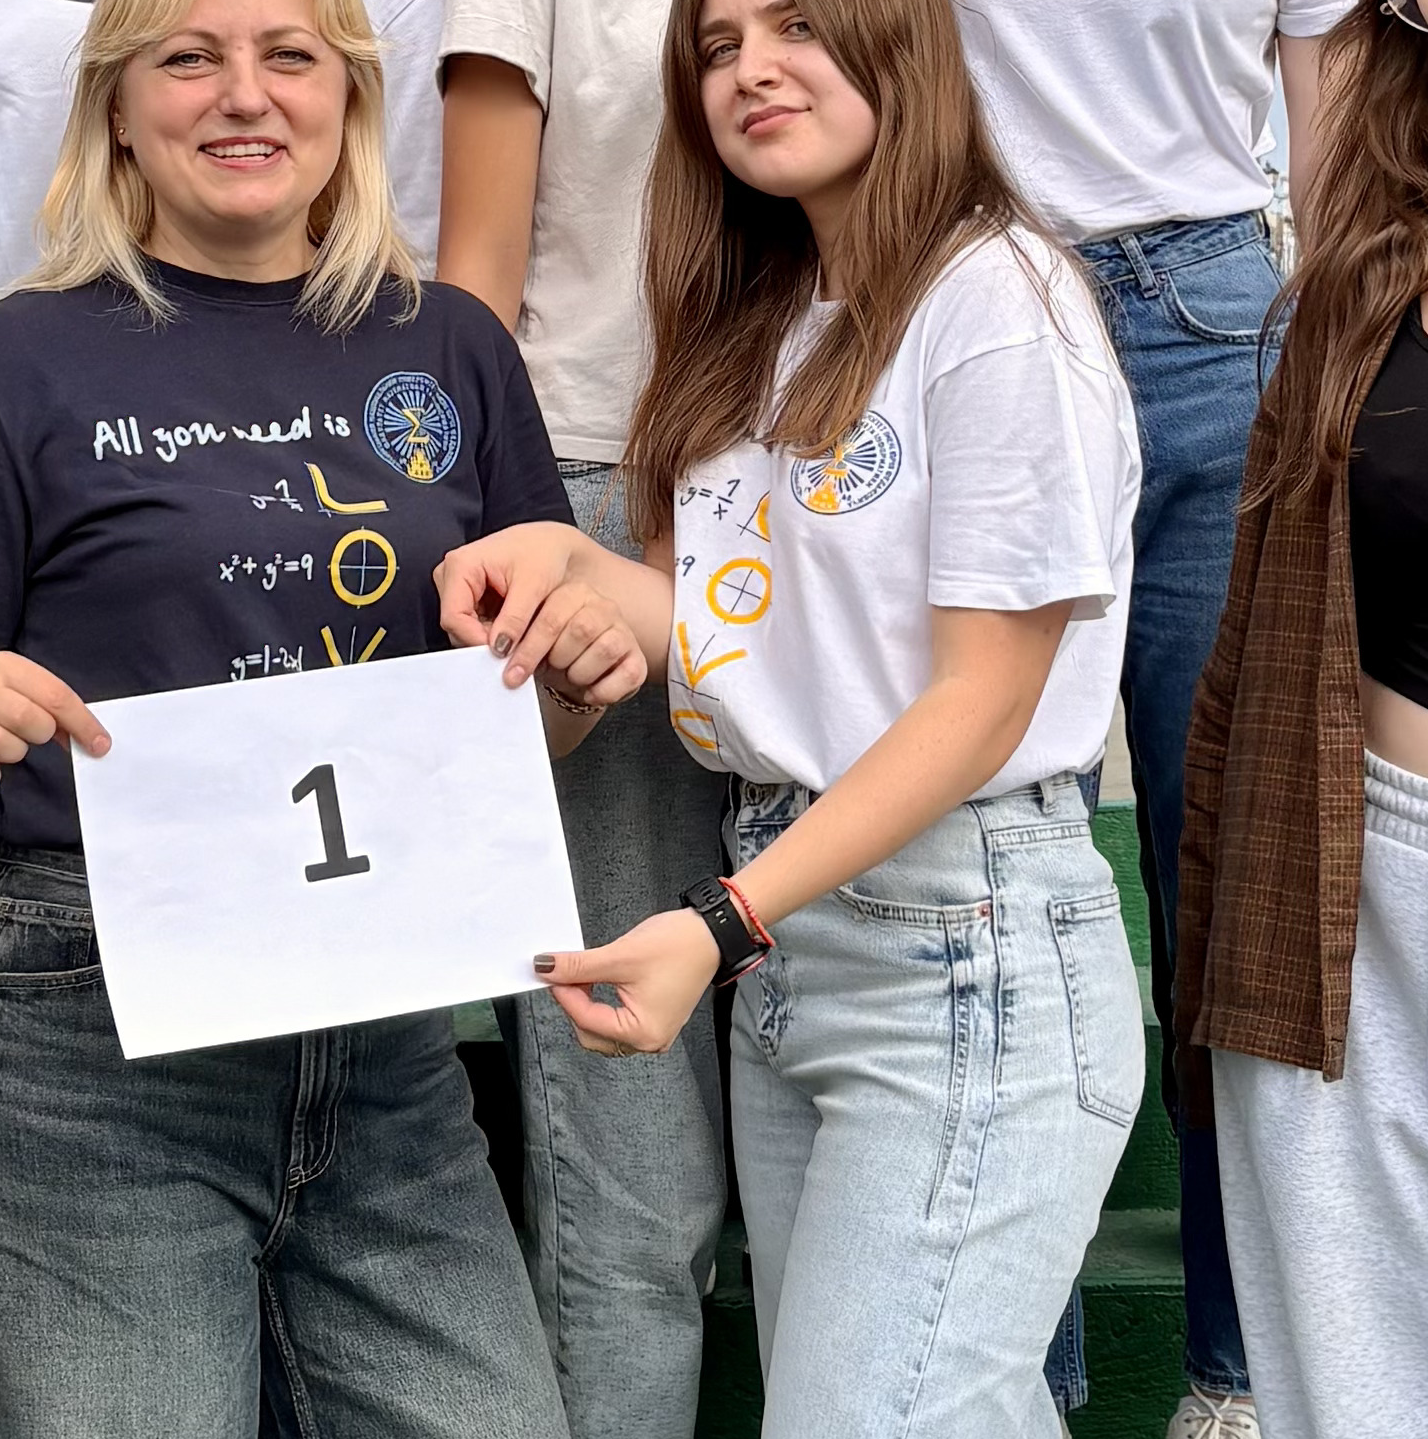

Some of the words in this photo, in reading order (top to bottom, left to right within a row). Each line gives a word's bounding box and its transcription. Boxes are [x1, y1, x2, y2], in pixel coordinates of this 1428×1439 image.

[93, 416, 144, 461] All
[152, 422, 227, 463] you
[231, 405, 313, 443] need
[323, 413, 352, 437] is
[291, 764, 370, 883] 1
